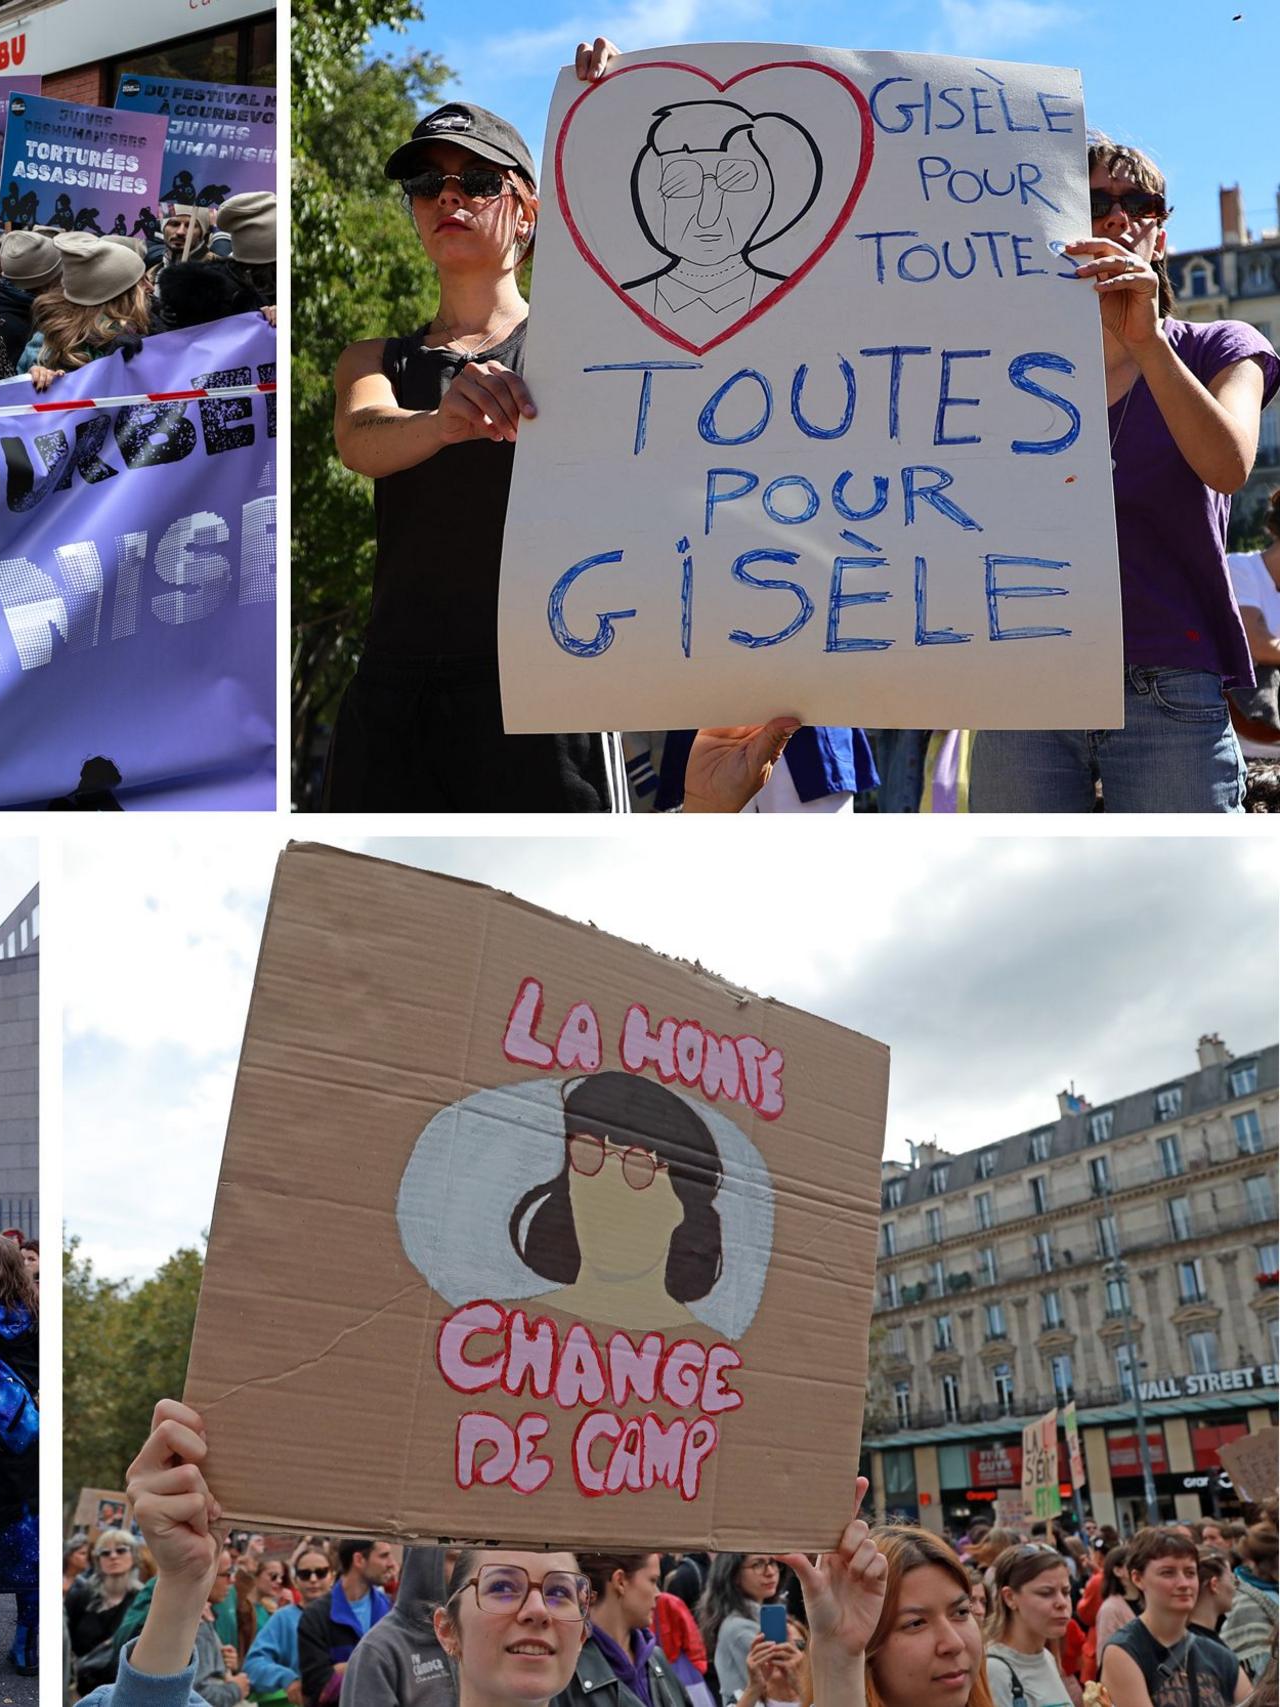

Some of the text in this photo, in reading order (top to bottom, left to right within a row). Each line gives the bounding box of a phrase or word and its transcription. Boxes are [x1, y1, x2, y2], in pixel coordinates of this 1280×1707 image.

[172, 87, 261, 106] FESTIVAL
[174, 104, 277, 124] COURBEVO
[869, 67, 1074, 136] GISÈLE
[26, 140, 139, 172] TORTURÉES
[168, 120, 250, 141] JUIVES
[12, 160, 148, 195] ASSASSINÉES
[917, 156, 1060, 213] POUR
[855, 230, 1080, 285] TOUTES
[583, 345, 1081, 456] TOUTES
[705, 465, 983, 535] POUR
[502, 976, 786, 1121] LA HONTE
[437, 1299, 744, 1415] CHANGE
[1129, 1375, 1181, 1401] WALL
[1185, 1367, 1255, 1395] STREET
[455, 1410, 718, 1502] DE CAMP
